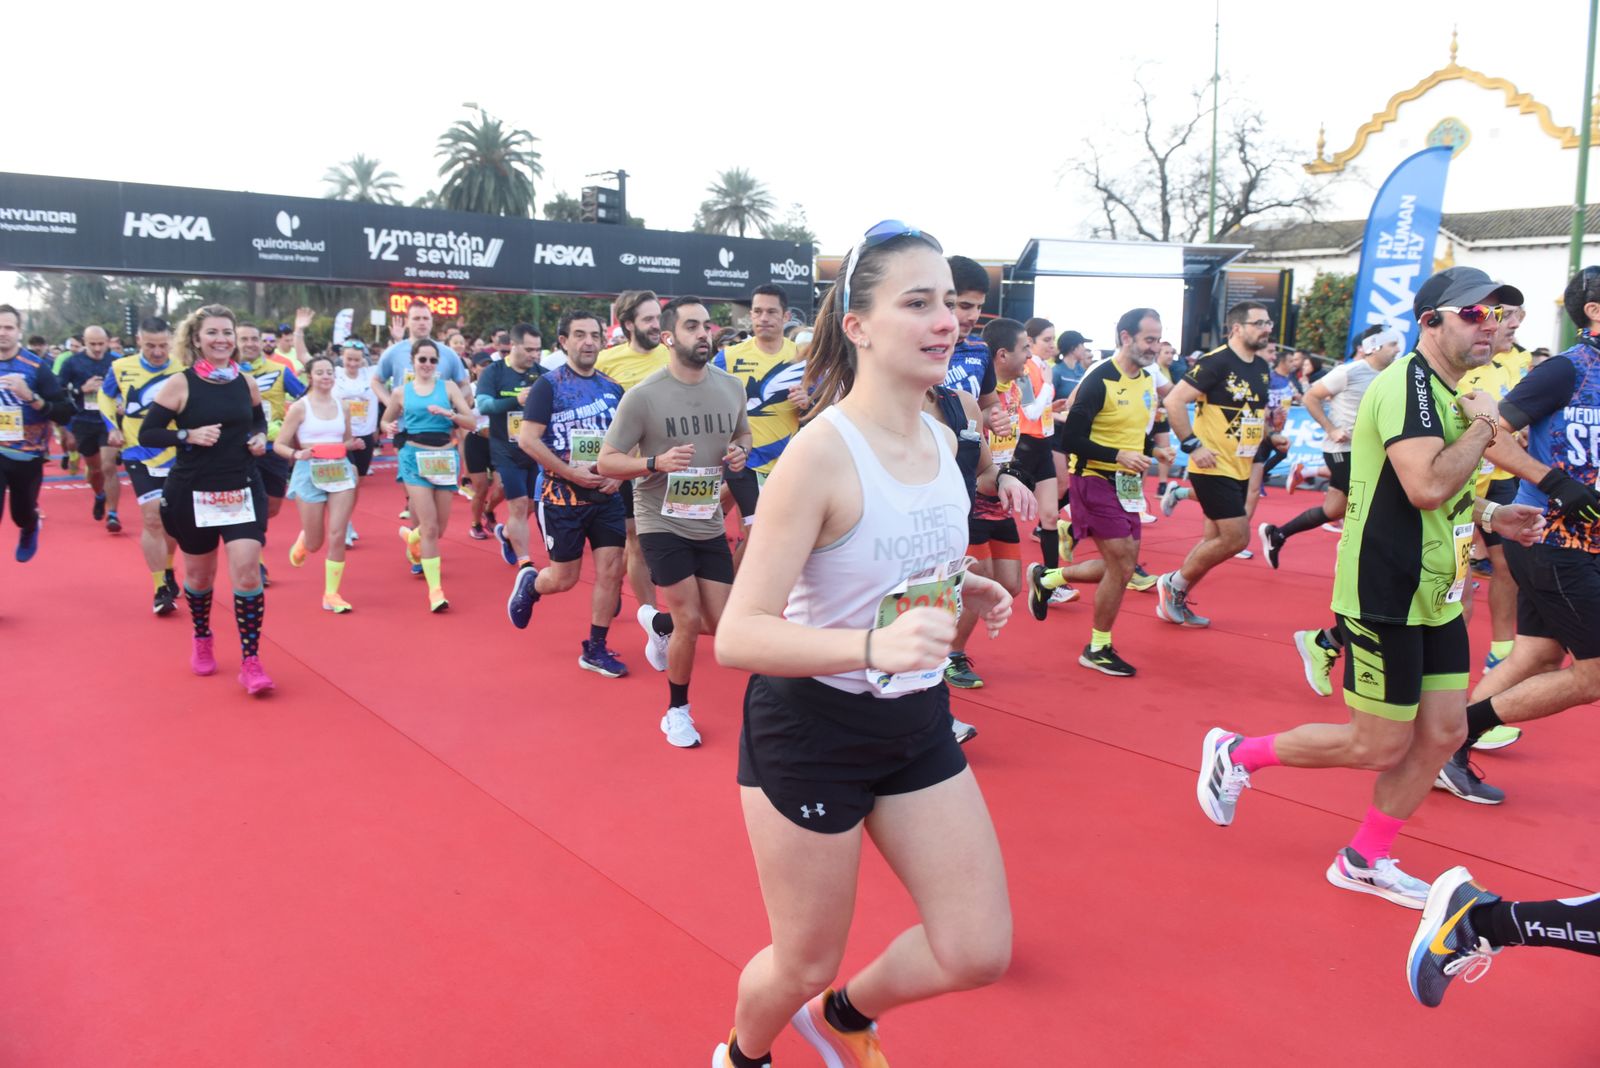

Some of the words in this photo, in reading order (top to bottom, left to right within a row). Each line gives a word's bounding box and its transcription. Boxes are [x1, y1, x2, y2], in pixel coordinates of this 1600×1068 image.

[0, 208, 77, 224] HYUNDAI
[123, 211, 215, 242] HOKA
[1392, 195, 1417, 260] HUMAN
[390, 229, 485, 251] maratón
[1376, 231, 1394, 259] FLY
[1407, 232, 1425, 260] FLY
[295, 254, 319, 263] Partner
[534, 243, 596, 267] HOKA
[638, 255, 681, 267] HYUNDAI
[404, 267, 417, 277] 28
[418, 269, 446, 279] enero
[446, 270, 470, 280] 2024
[665, 413, 735, 438] NOBULL
[1563, 406, 1600, 425] MEDI
[673, 479, 715, 496] 15531
[908, 506, 946, 533] THE
[873, 526, 949, 561] NORTH
[899, 549, 949, 580] FACE
